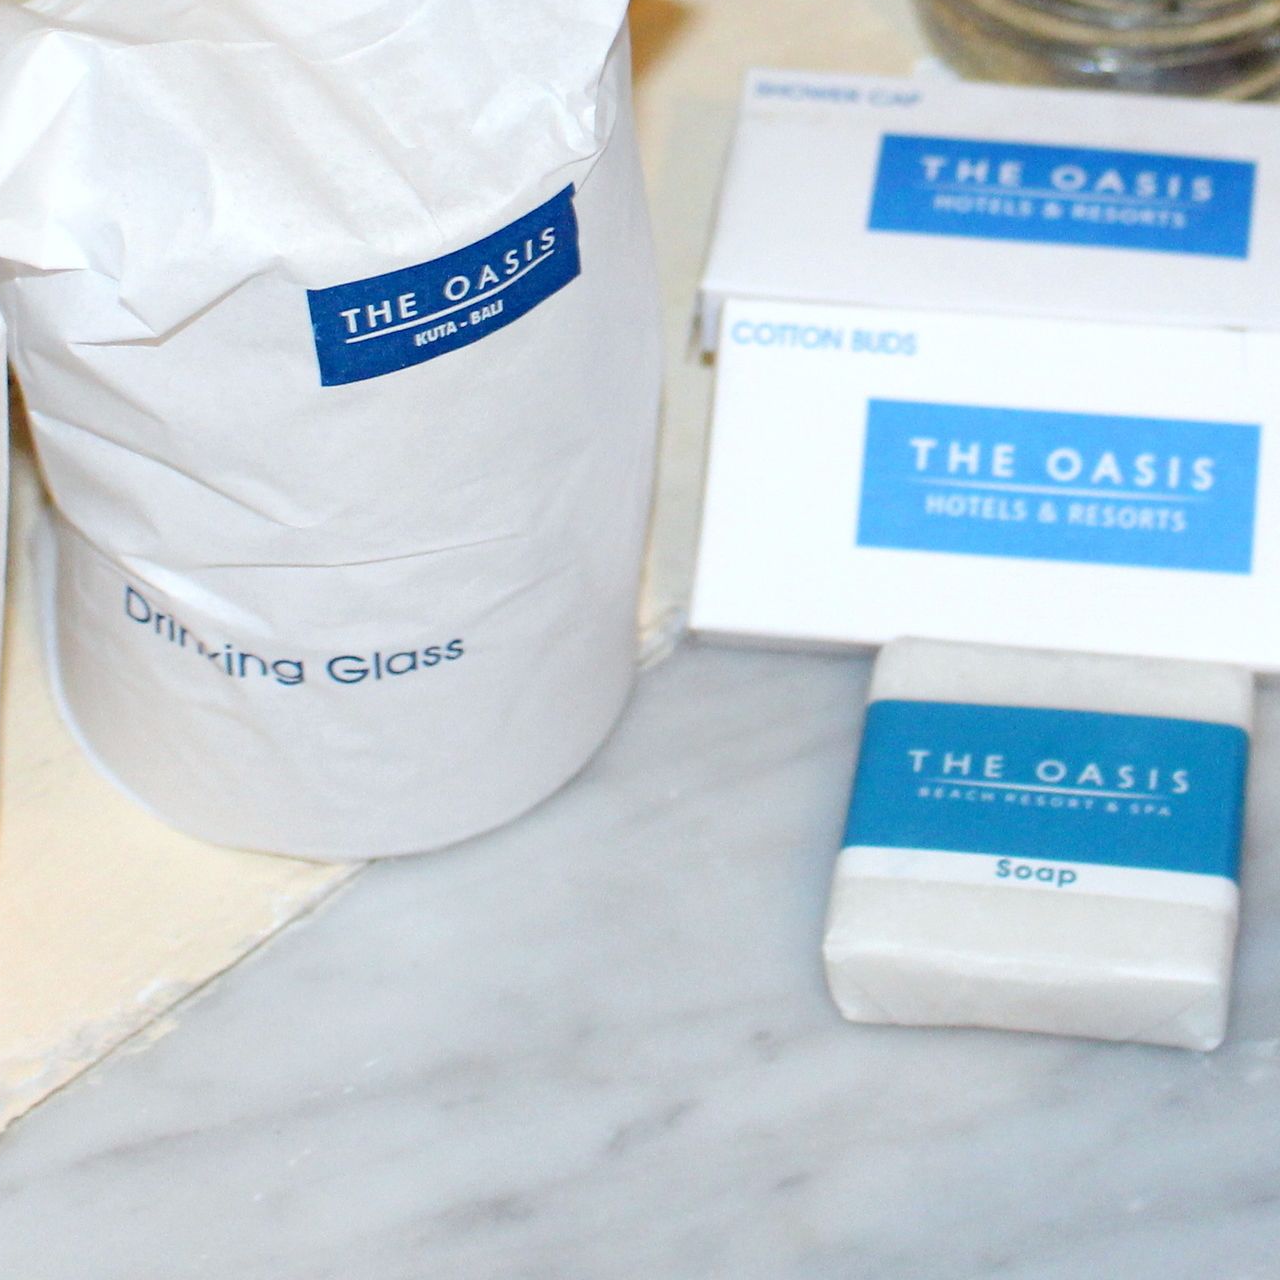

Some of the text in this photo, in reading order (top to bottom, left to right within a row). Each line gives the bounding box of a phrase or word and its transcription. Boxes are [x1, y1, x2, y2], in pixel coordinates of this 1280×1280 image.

[921, 154, 1214, 203] THE OASIS
[932, 193, 1033, 219] HOTELS
[1071, 202, 1188, 229] RESORTS
[340, 227, 556, 334] THE OASIS
[415, 321, 458, 347] KUTA
[470, 299, 504, 326] BALI
[731, 320, 919, 356] COTTON BUDS
[909, 437, 1216, 492] THE OASIS
[924, 494, 1188, 533] HOTELS & RESORTS
[326, 637, 465, 685] Glass
[908, 749, 1190, 795] THE OASIS
[918, 786, 996, 802] BEACH
[995, 858, 1078, 889] Soap
